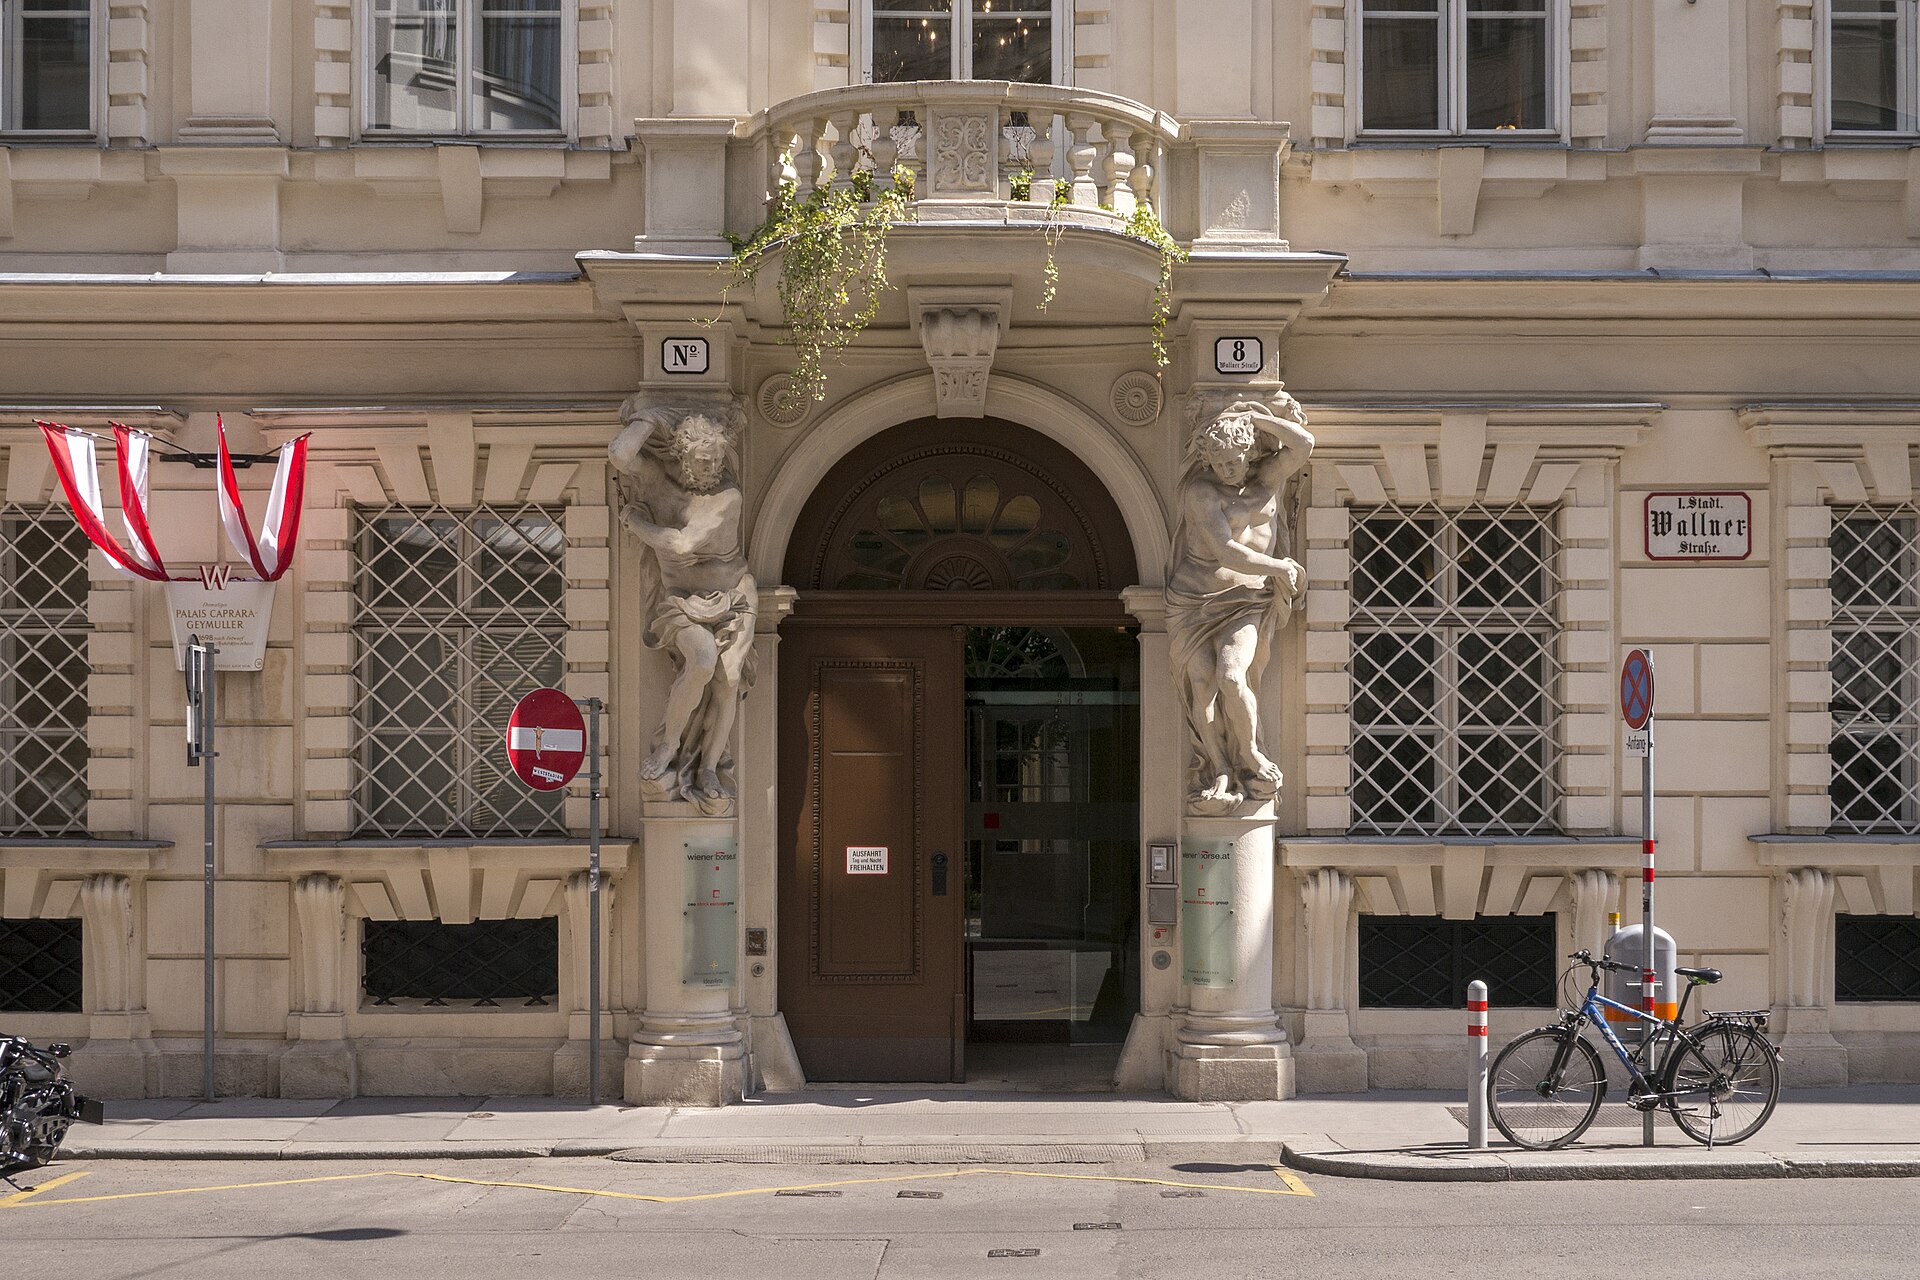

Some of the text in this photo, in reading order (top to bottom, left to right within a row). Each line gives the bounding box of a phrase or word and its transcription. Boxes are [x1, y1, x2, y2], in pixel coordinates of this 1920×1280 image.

[1232, 340, 1246, 361] 8
[200, 565, 232, 590] W
[176, 609, 258, 618] PALAIS CAPRARA-
[687, 853, 713, 861] wiener
[852, 850, 882, 858] AUSFAHRT
